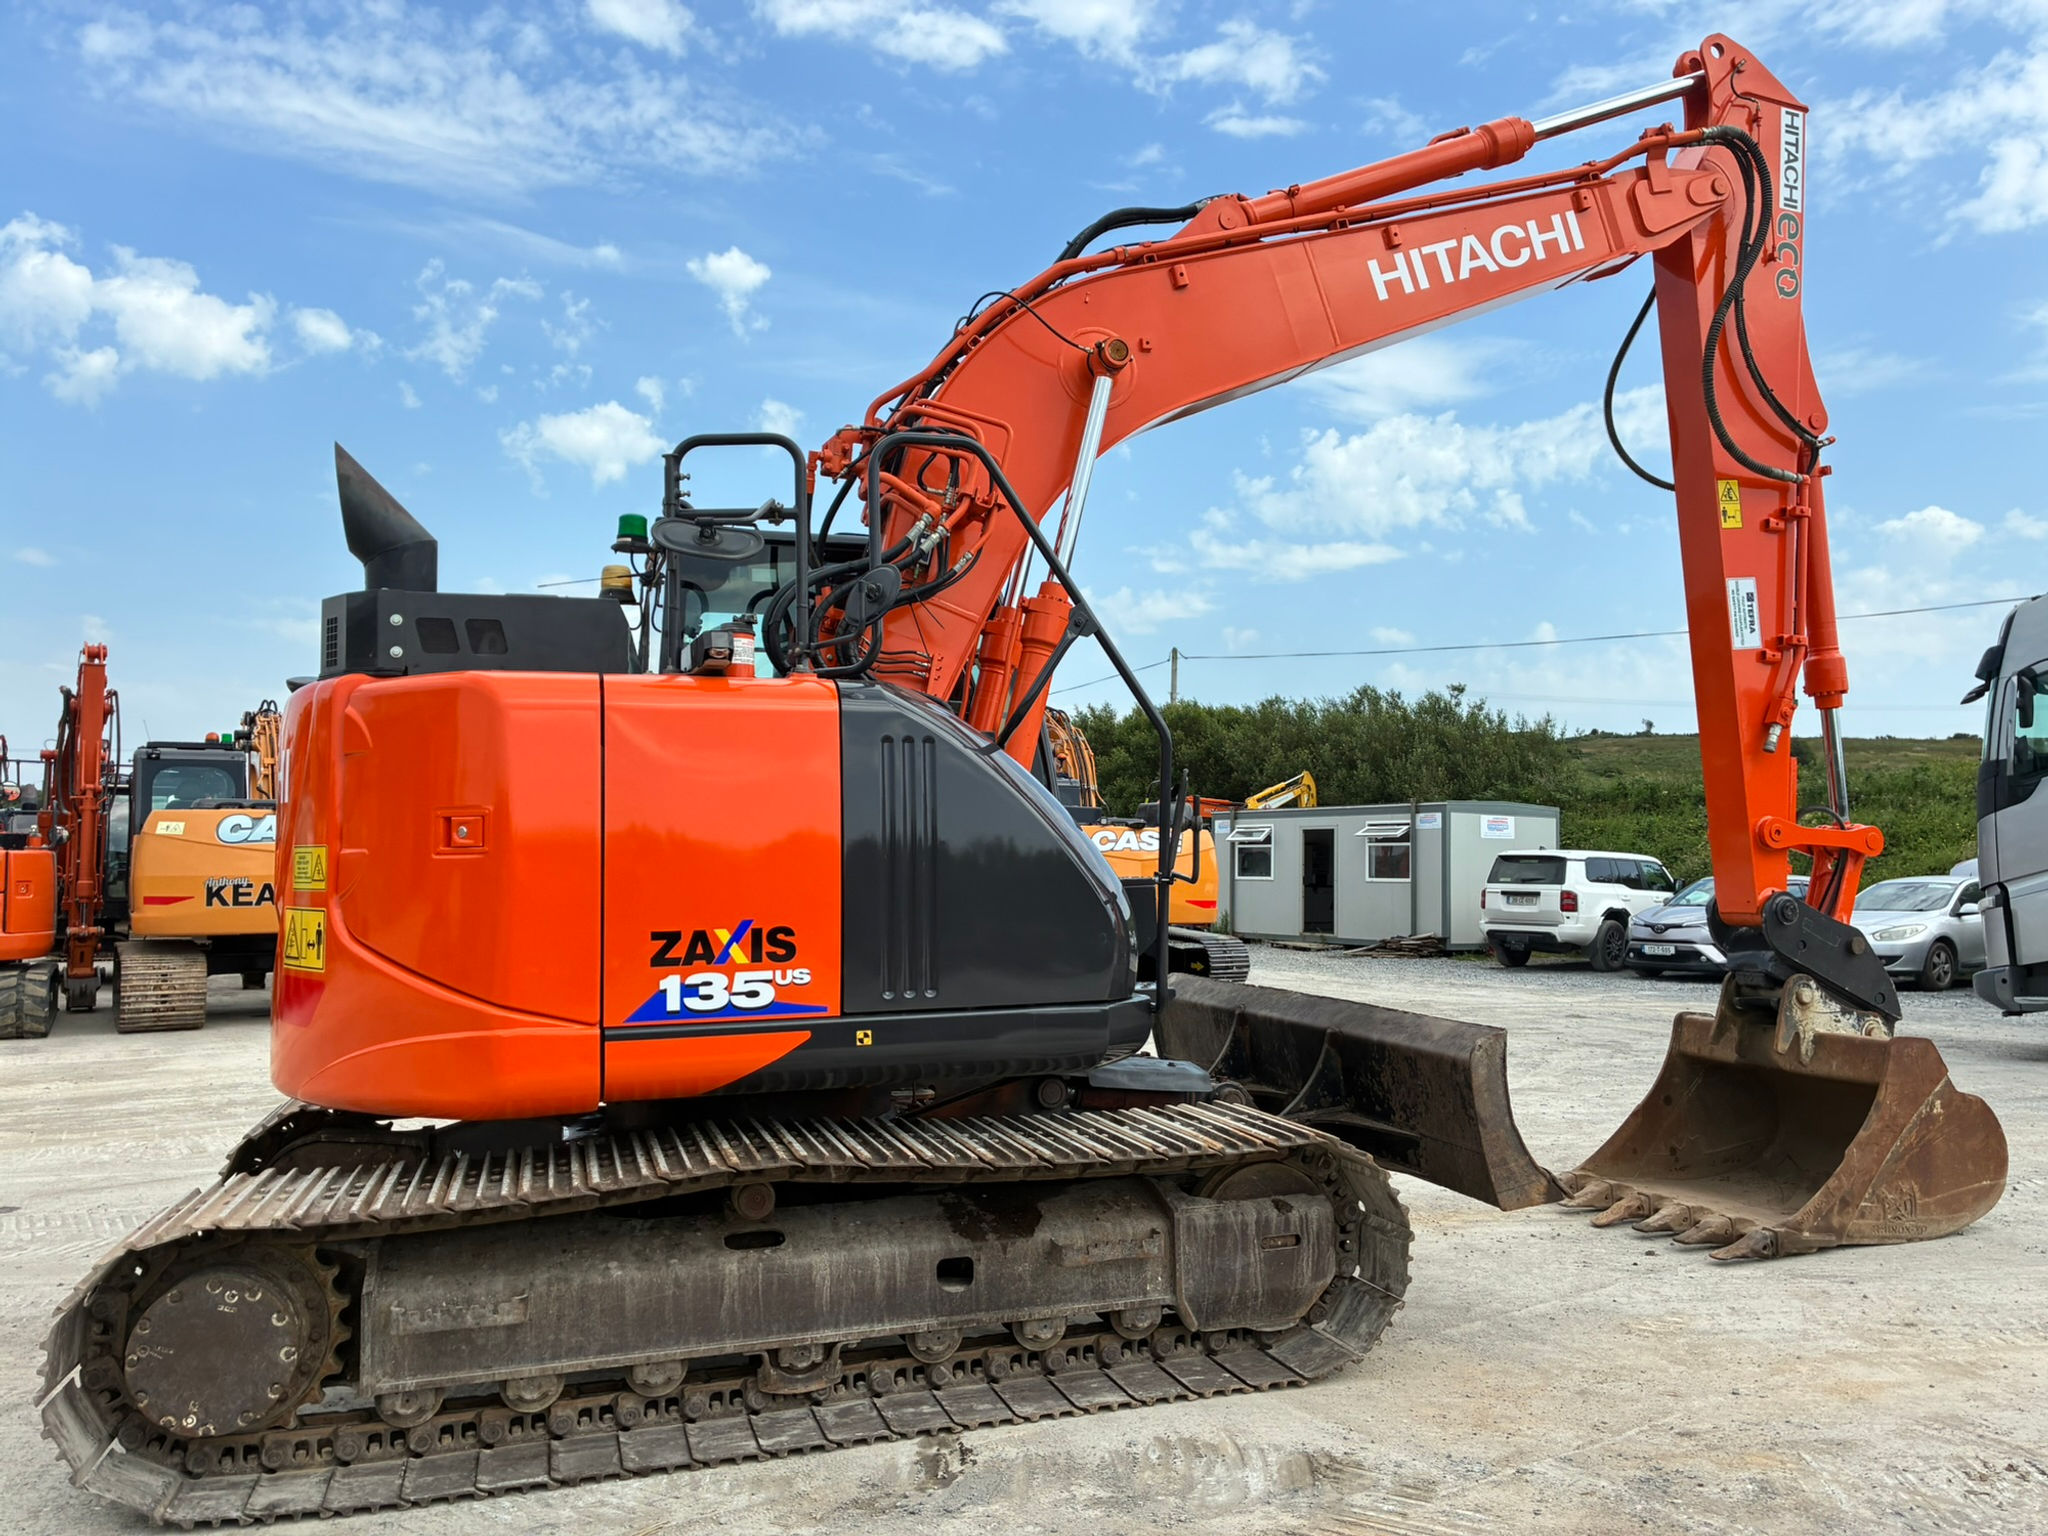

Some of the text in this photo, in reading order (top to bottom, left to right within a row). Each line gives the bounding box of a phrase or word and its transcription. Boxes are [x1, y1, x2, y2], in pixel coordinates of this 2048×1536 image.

[1784, 110, 1800, 210] HITACHI
[1367, 210, 1585, 301] HITACHI
[1747, 602, 1756, 634] TEFRA
[1090, 829, 1183, 853] CAS
[650, 919, 797, 968] ZAXIS
